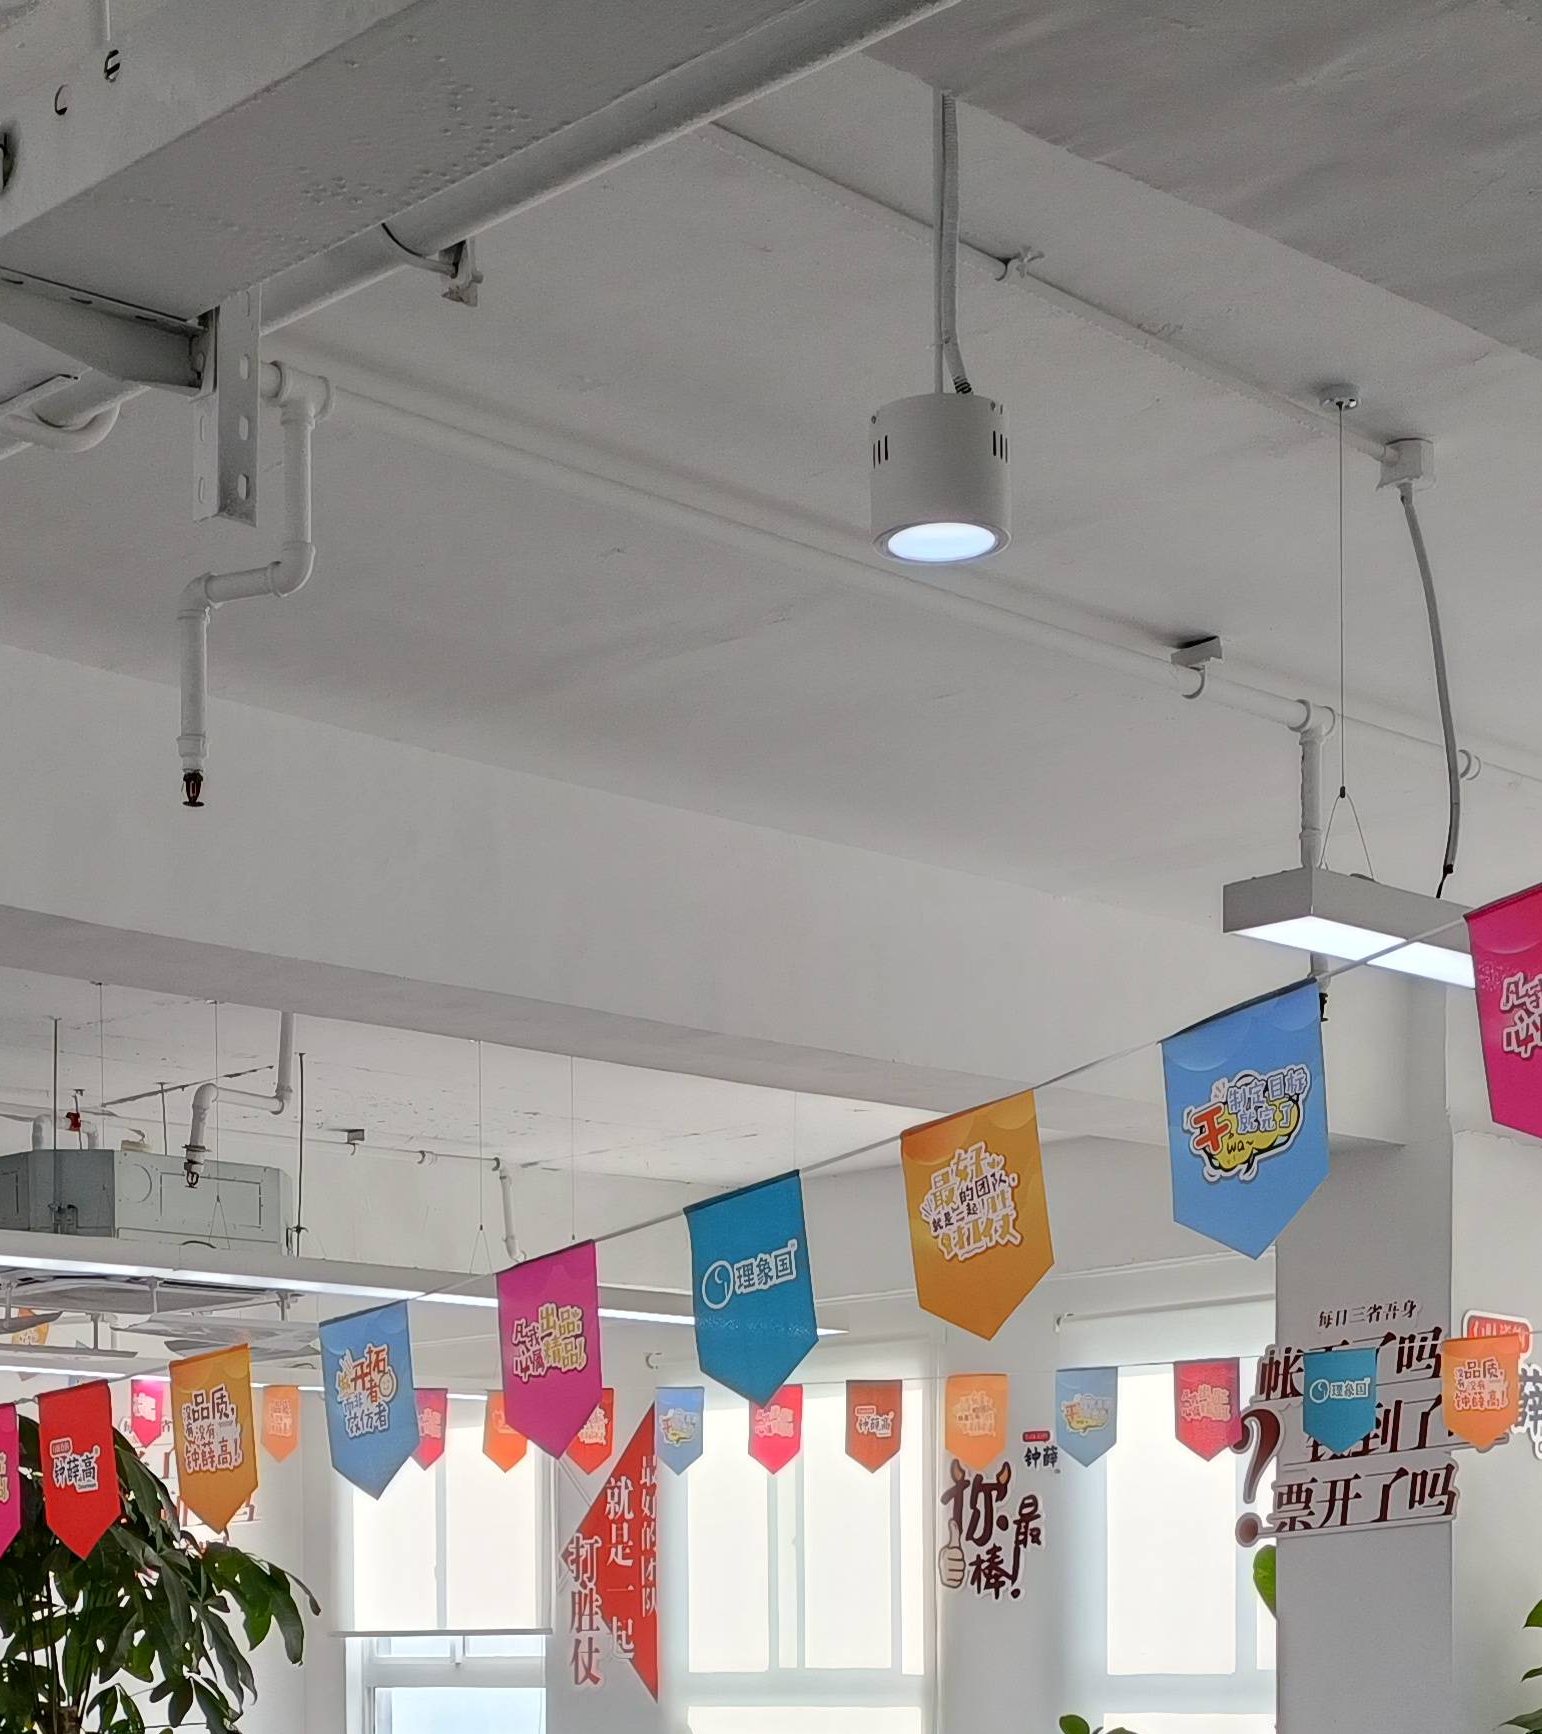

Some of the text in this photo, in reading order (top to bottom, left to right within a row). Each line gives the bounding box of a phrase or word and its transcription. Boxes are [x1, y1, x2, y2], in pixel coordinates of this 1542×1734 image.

[1227, 1068, 1307, 1114] 制定目标
[1237, 1102, 1296, 1133] 就完了
[735, 1250, 794, 1290] 理象国
[1318, 1300, 1416, 1328] 每日三省吾身
[1274, 1462, 1457, 1534] 票开了吗
[605, 1476, 635, 1659] 就是一起
[568, 1535, 601, 1686] 打胜仗
